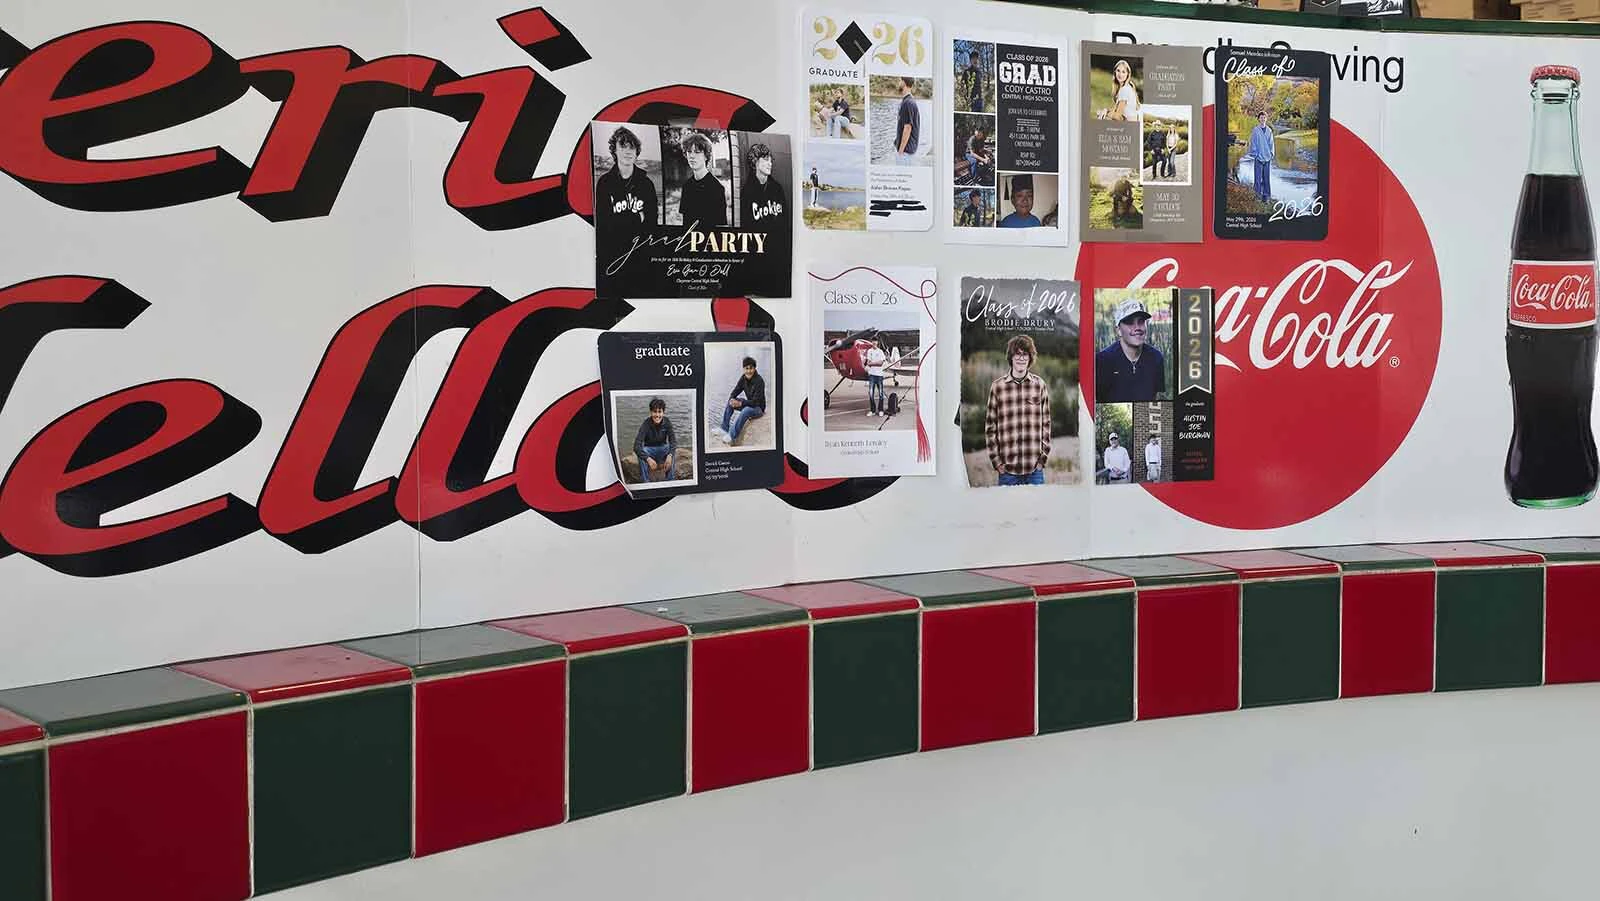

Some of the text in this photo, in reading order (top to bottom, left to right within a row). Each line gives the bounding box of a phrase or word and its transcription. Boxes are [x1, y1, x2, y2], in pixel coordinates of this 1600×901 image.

[1006, 53, 1025, 61] CLASS
[808, 67, 859, 79] GRADUATE
[999, 61, 1056, 87] GRAD
[1222, 55, 1296, 83] Class of
[1004, 85, 1052, 96] CODY CASTRO
[1268, 196, 1324, 223] 2026
[606, 220, 768, 275] grad PARTY
[824, 290, 858, 305] Class
[861, 290, 875, 305] of
[1514, 273, 1592, 311] Coca-Cola
[965, 283, 1077, 322] Class of 2026
[1126, 257, 1414, 369] a-Cola
[985, 318, 1056, 327] BRODIE DRURY
[635, 343, 690, 360] graduate
[663, 364, 693, 377] 2026
[1183, 414, 1207, 422] AUSTIN
[1188, 423, 1202, 431] JOE
